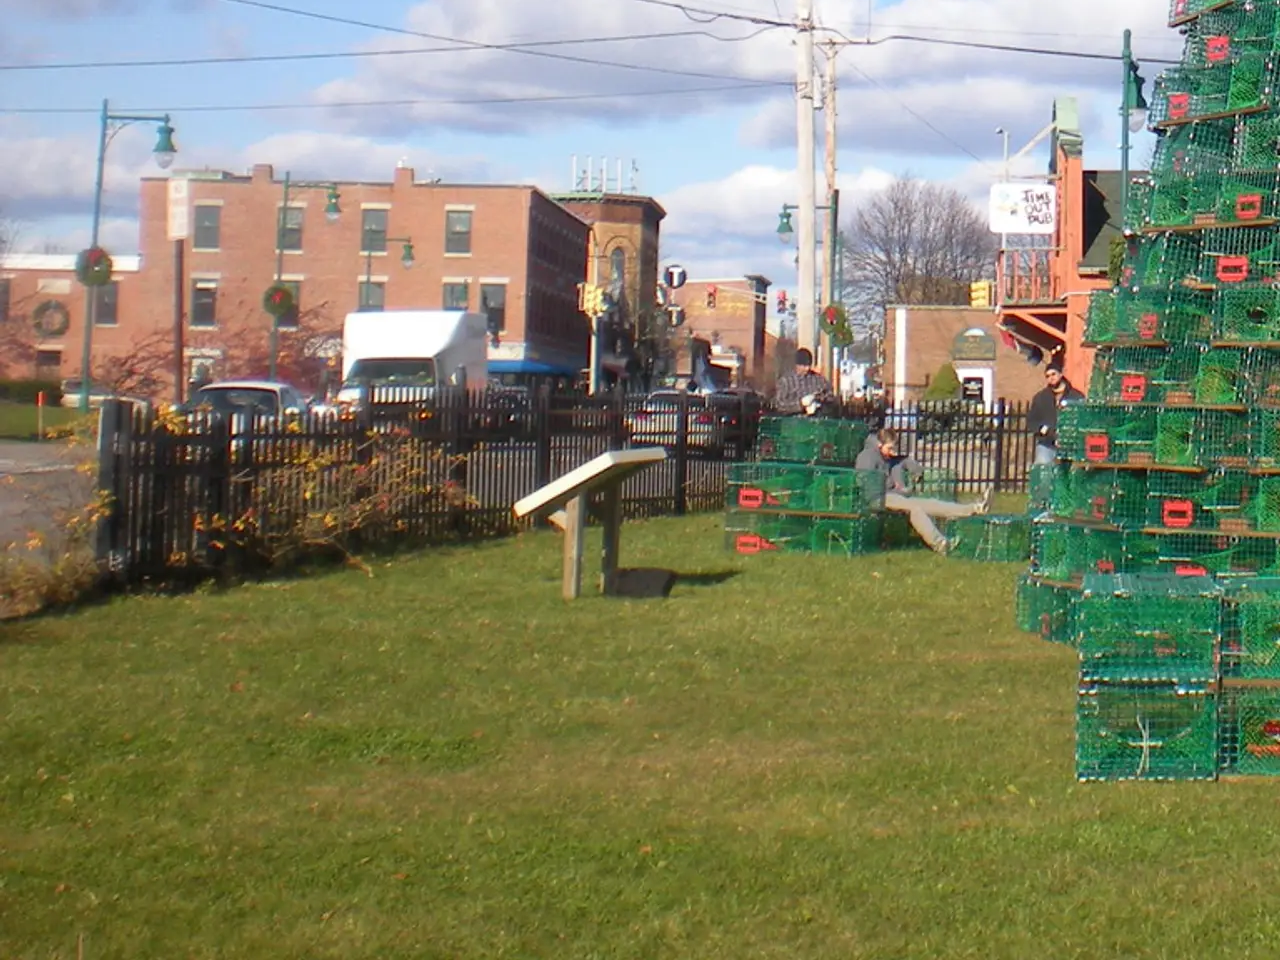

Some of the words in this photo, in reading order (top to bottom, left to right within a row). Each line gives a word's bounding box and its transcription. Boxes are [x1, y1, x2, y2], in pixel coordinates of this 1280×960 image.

[1021, 189, 1051, 203] TIME
[1024, 202, 1050, 214] OUT
[1028, 213, 1053, 226] PUB
